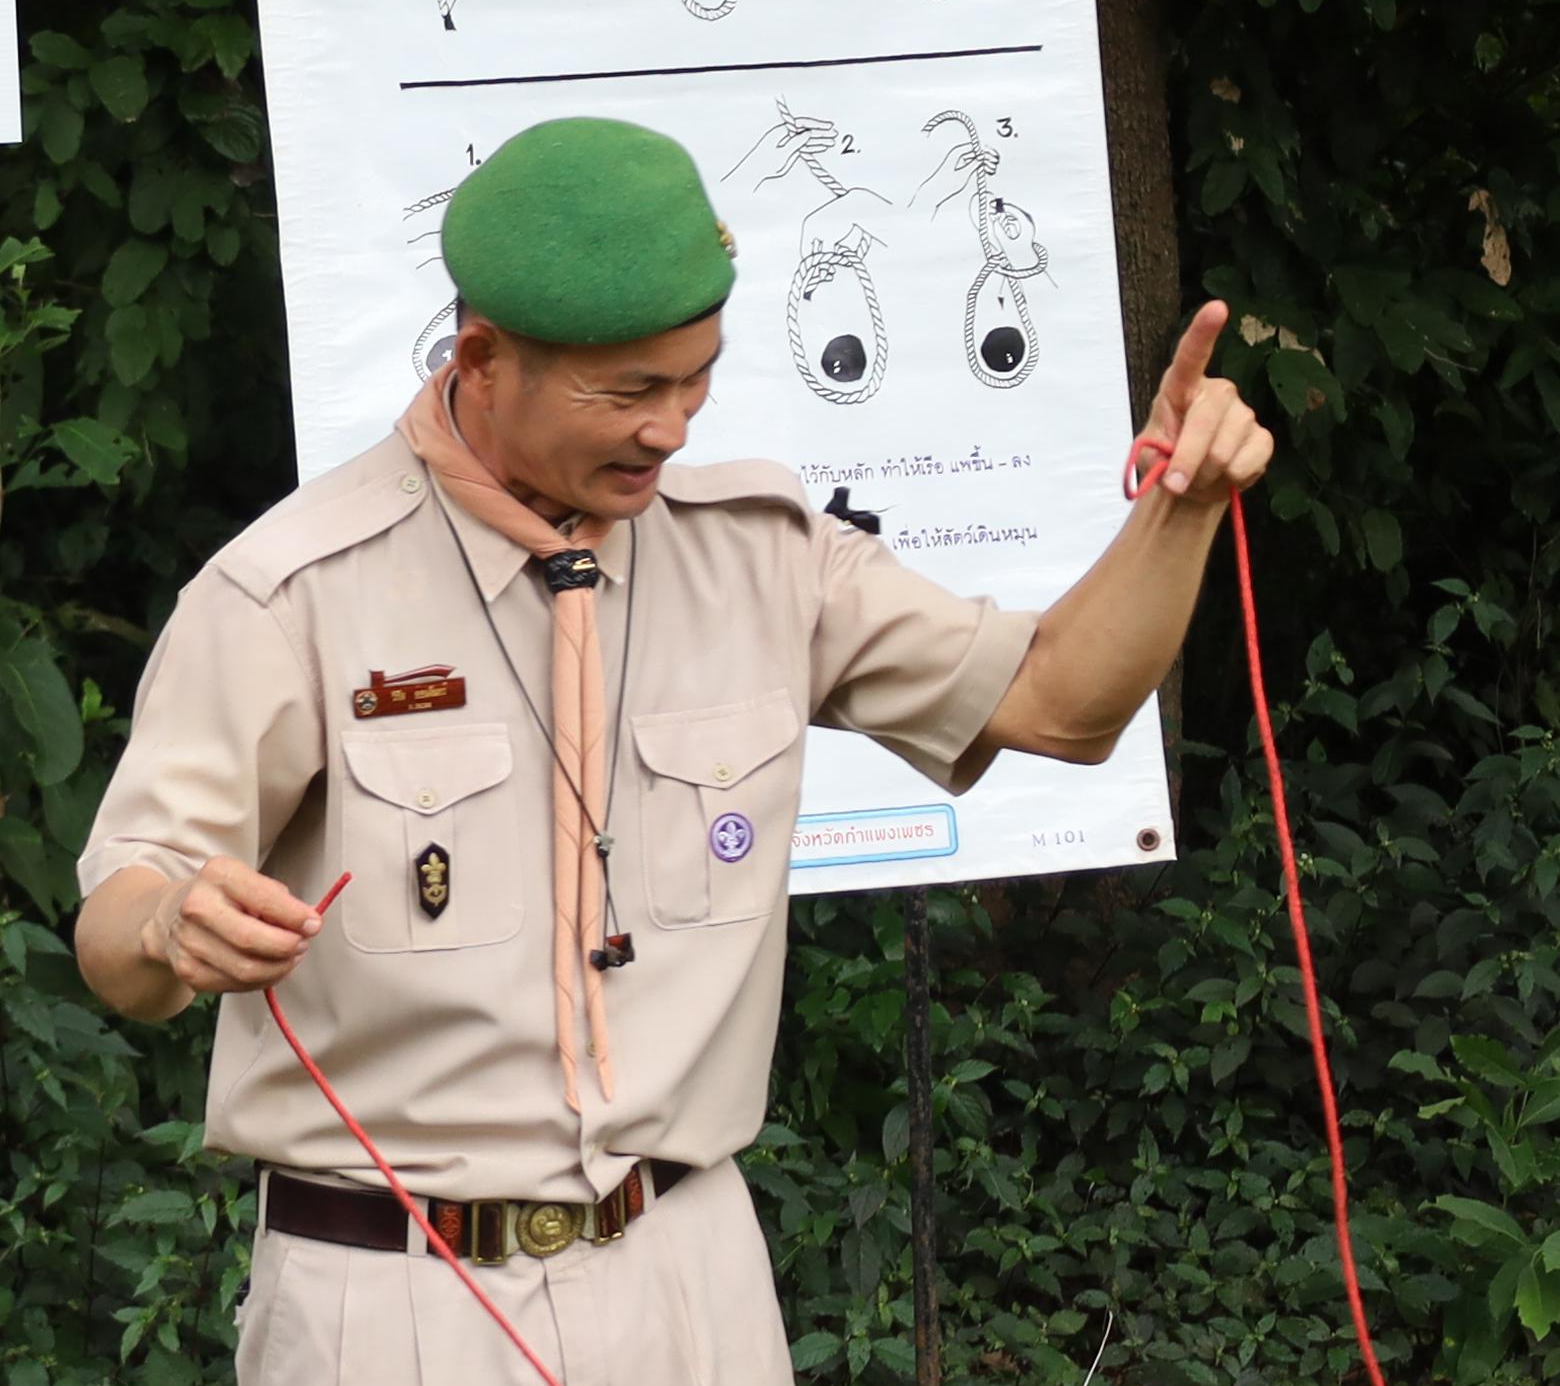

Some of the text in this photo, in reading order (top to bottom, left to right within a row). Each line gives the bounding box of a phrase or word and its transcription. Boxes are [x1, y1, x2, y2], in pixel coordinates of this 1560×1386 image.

[996, 117, 1019, 139] 3.
[465, 143, 482, 166] 1.
[840, 134, 862, 155] 2.
[880, 455, 944, 479] ทำให้เรือ
[1012, 454, 1032, 469] ลง
